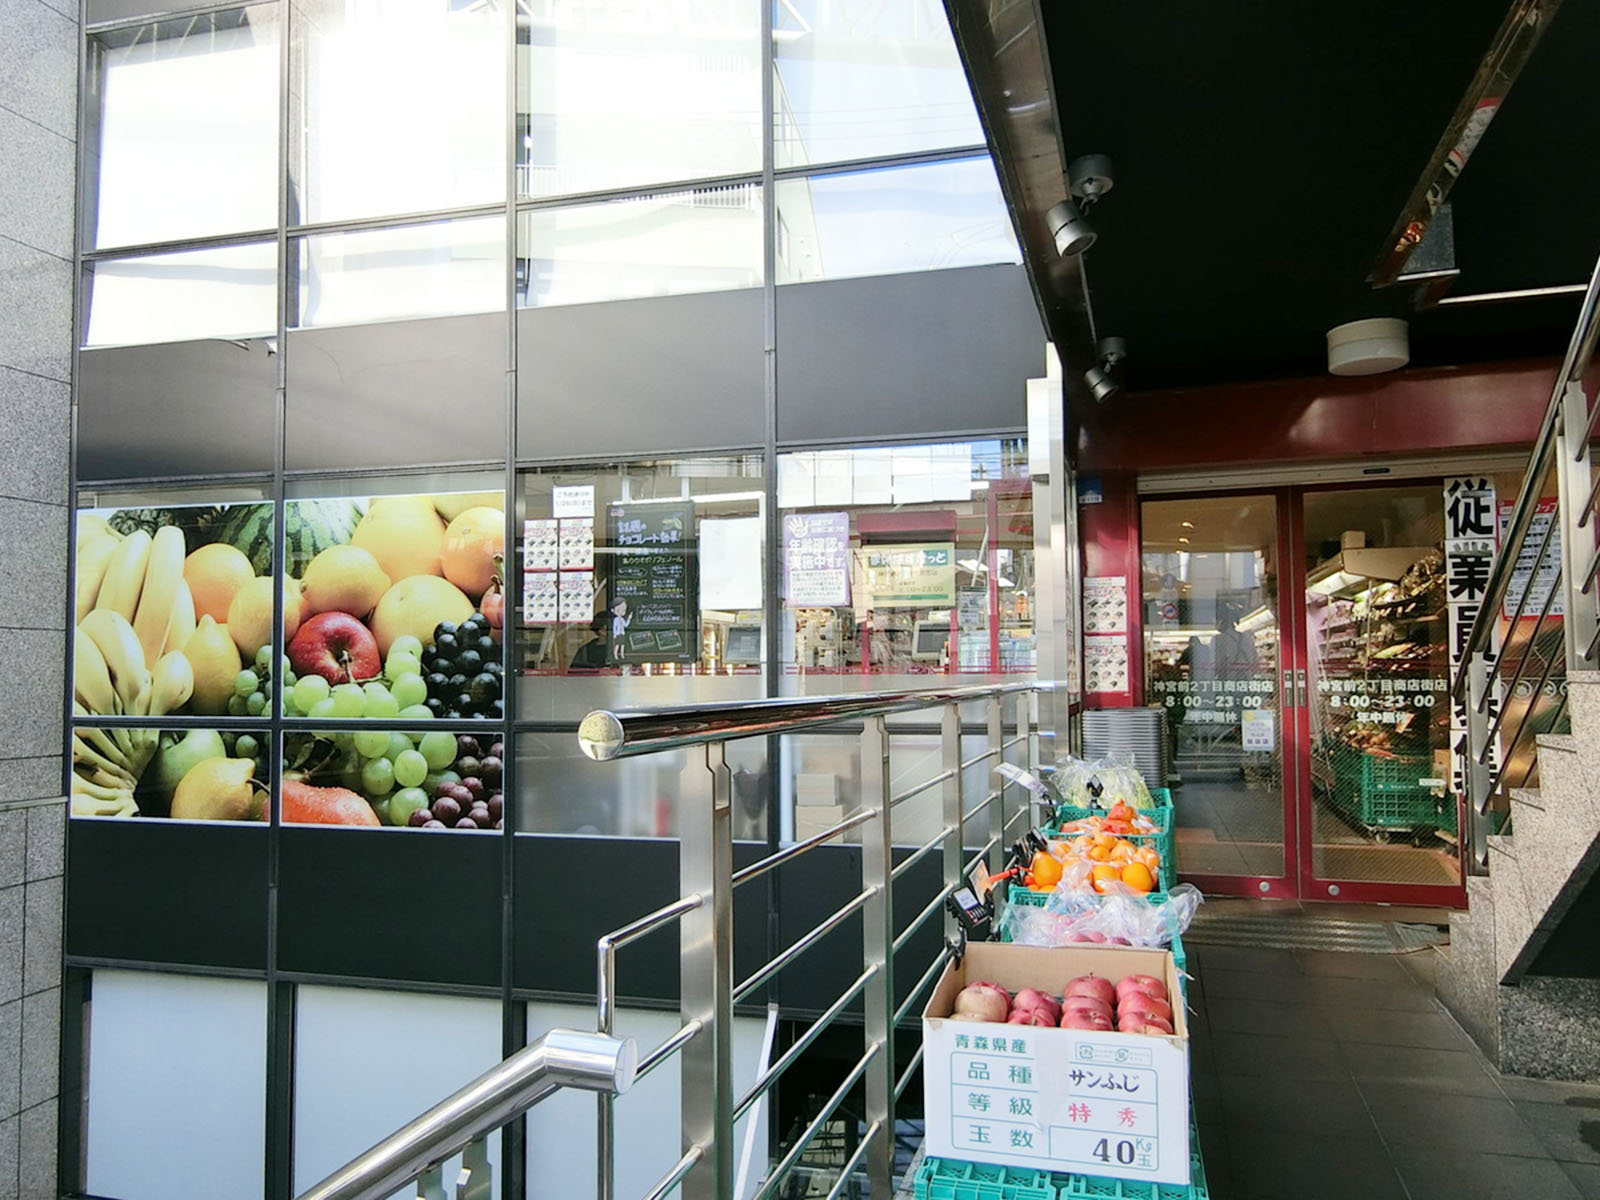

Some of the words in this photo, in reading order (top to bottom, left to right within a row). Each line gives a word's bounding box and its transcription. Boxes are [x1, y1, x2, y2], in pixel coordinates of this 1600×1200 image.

[1448, 478, 1499, 790] 従業員
[1153, 680, 1274, 693] 神宮前2丁目商店街店
[1317, 679, 1448, 693] 神宮前2丁目商店街店
[955, 1033, 1027, 1054] 青森県産
[967, 1061, 1033, 1084] 品種
[1068, 1069, 1141, 1093] サンふじ
[967, 1092, 1033, 1116] 等級
[1092, 1137, 1136, 1165] 40
